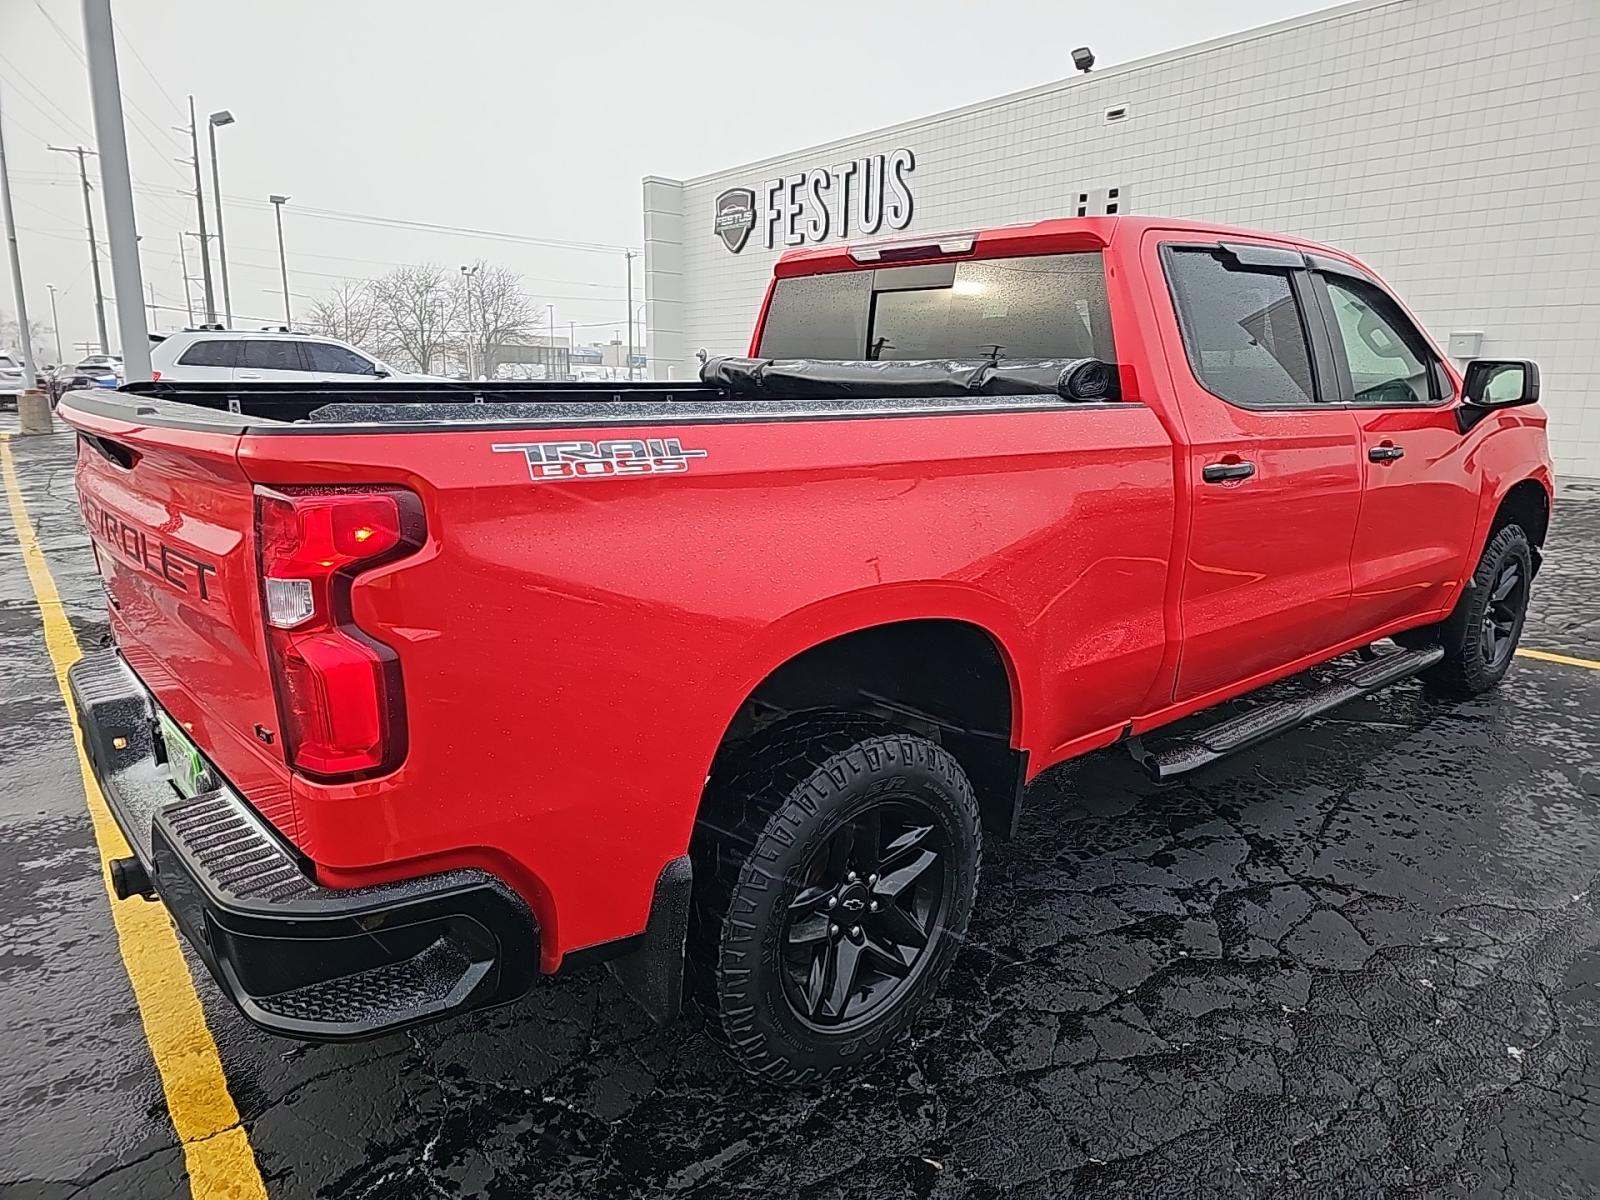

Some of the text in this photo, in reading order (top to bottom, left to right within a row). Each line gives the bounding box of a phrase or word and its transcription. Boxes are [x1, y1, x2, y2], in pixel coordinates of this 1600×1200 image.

[763, 148, 916, 249] FESTUS
[716, 210, 753, 227] FESTUS
[491, 438, 708, 463] TRAIL
[530, 457, 689, 481] BOSS
